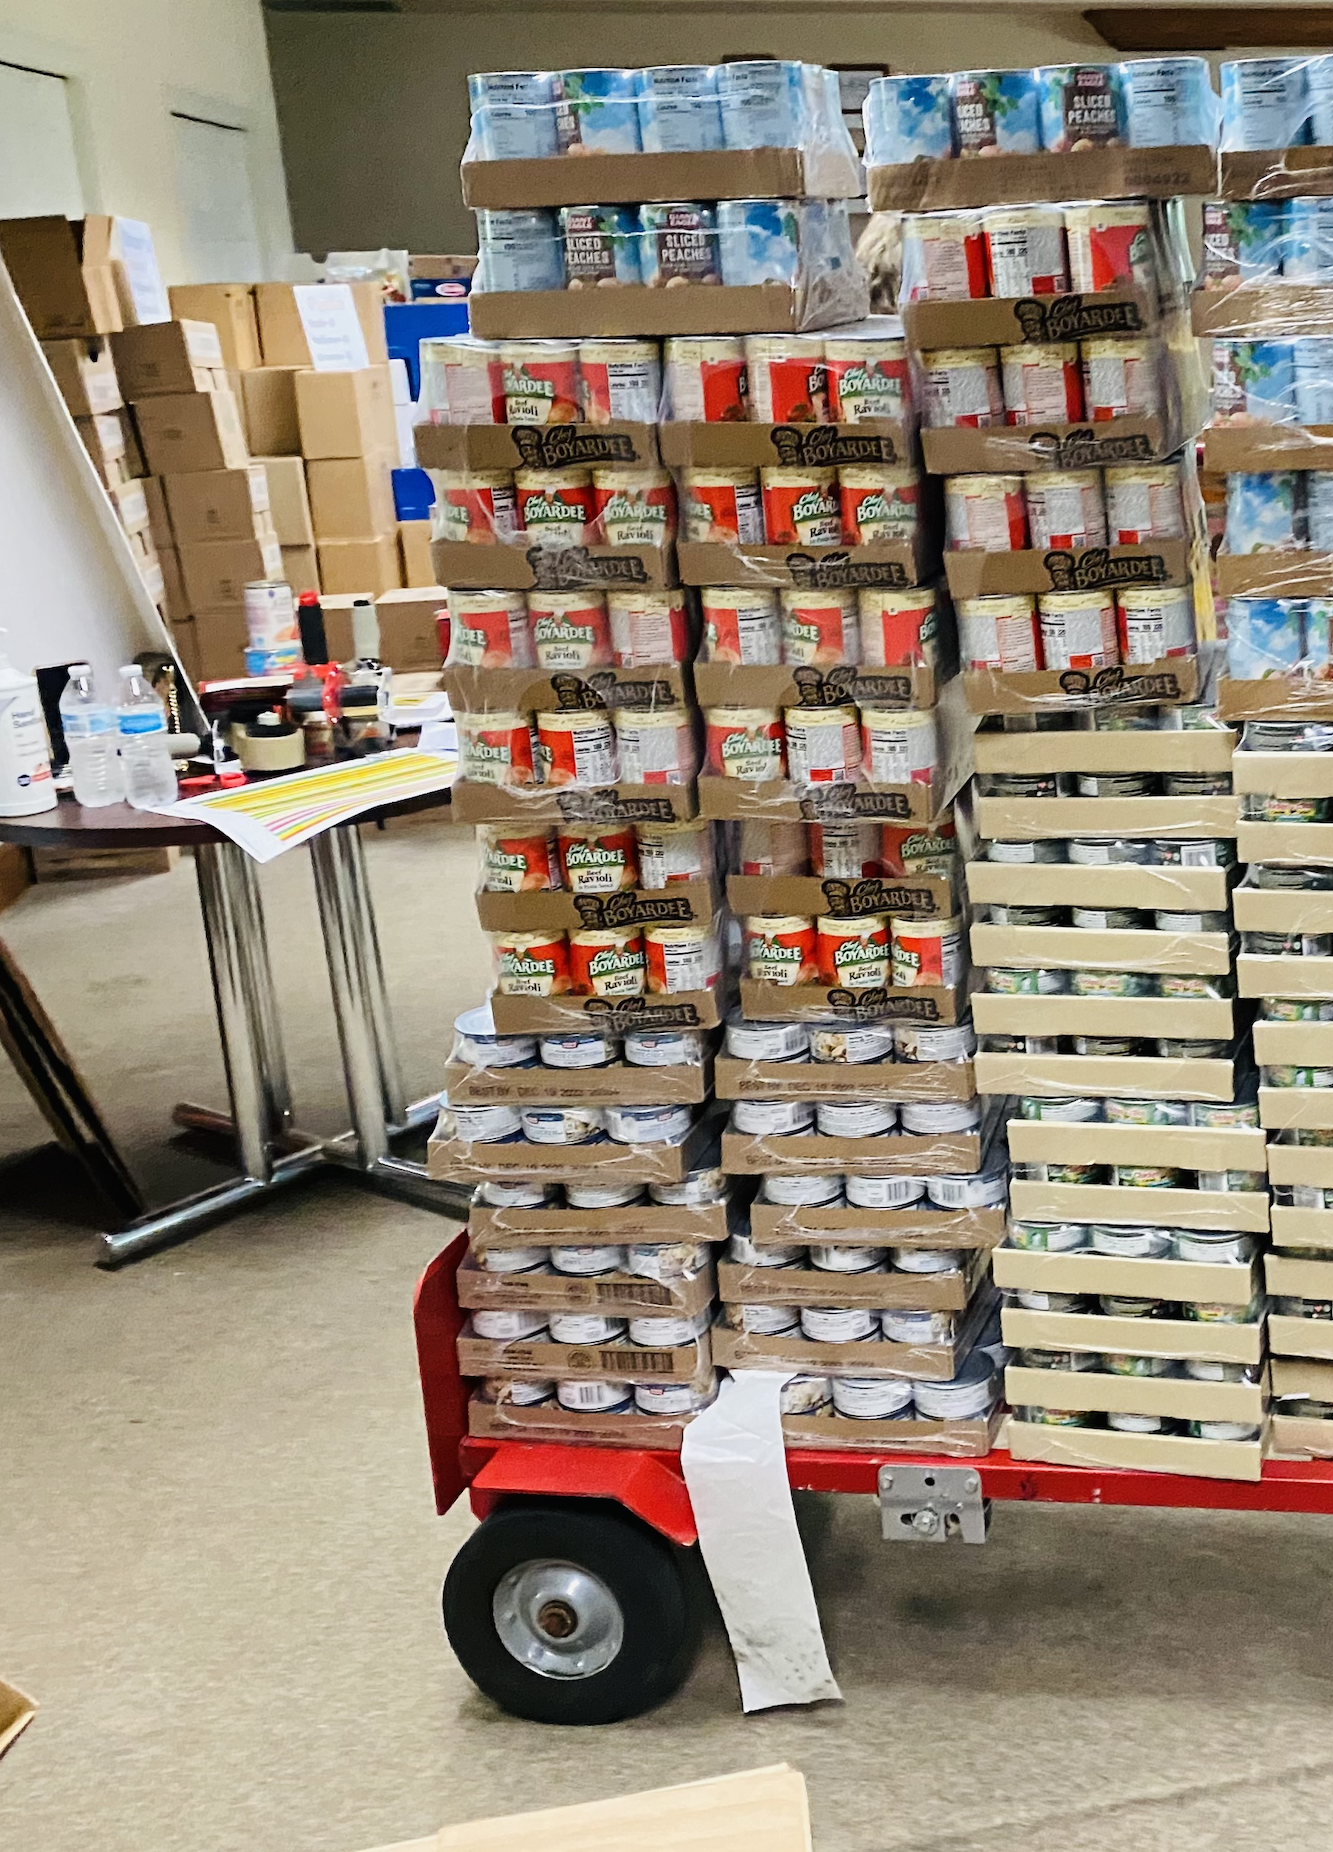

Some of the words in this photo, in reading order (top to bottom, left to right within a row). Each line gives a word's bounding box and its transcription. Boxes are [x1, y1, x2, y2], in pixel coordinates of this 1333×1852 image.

[1074, 95, 1111, 108] SLICED
[957, 103, 983, 118] LICED
[1068, 109, 1116, 124] PEACHES
[958, 117, 990, 132] ACHES
[566, 237, 601, 251] SLICED
[666, 234, 706, 248] SLICED
[564, 251, 610, 265] PEACHES
[662, 248, 712, 262] PEACHES
[1049, 305, 1138, 337] BOYARDEE
[504, 378, 554, 397] YARDEE
[839, 379, 902, 395] BOYARDEE
[509, 405, 538, 416] Ravioli
[550, 427, 573, 443] Chef
[810, 427, 833, 445] Chef
[543, 436, 634, 465] BOYARDEE
[803, 438, 893, 464] BOYARDEE
[526, 496, 544, 507] Chef
[800, 492, 820, 504] Chef
[862, 496, 882, 506] Chef
[524, 501, 586, 522] BOYARDEE
[793, 496, 839, 519] BOYARD
[617, 530, 654, 541] Ravioli
[817, 564, 905, 587] BOYARDEE
[1075, 558, 1162, 588] BOYARDEE
[534, 624, 595, 642] BOYARDEE
[545, 651, 581, 661] Ravioli
[823, 677, 909, 704] BOYARDEE
[726, 733, 746, 744] Chef
[722, 739, 781, 757] BOYARDEE
[589, 799, 672, 823] YARDEE
[568, 843, 585, 854] Chef
[487, 851, 526, 869] ARDEE
[566, 849, 625, 867] BOYARDEE
[578, 874, 613, 884] Ravioli
[856, 879, 882, 895] Chef
[610, 893, 633, 910] Chef
[849, 889, 935, 913] BOYARDEE
[604, 899, 692, 927] BOYARDEE
[840, 941, 860, 952] Chef
[595, 950, 615, 962] Chef
[849, 968, 882, 981] Ravioli
[508, 983, 541, 992] Ravioli
[604, 977, 638, 991] Ravioli
[861, 989, 886, 1005] Chef
[614, 1005, 698, 1031] BOYARDEE
[856, 1000, 938, 1021] BOYARDEE
